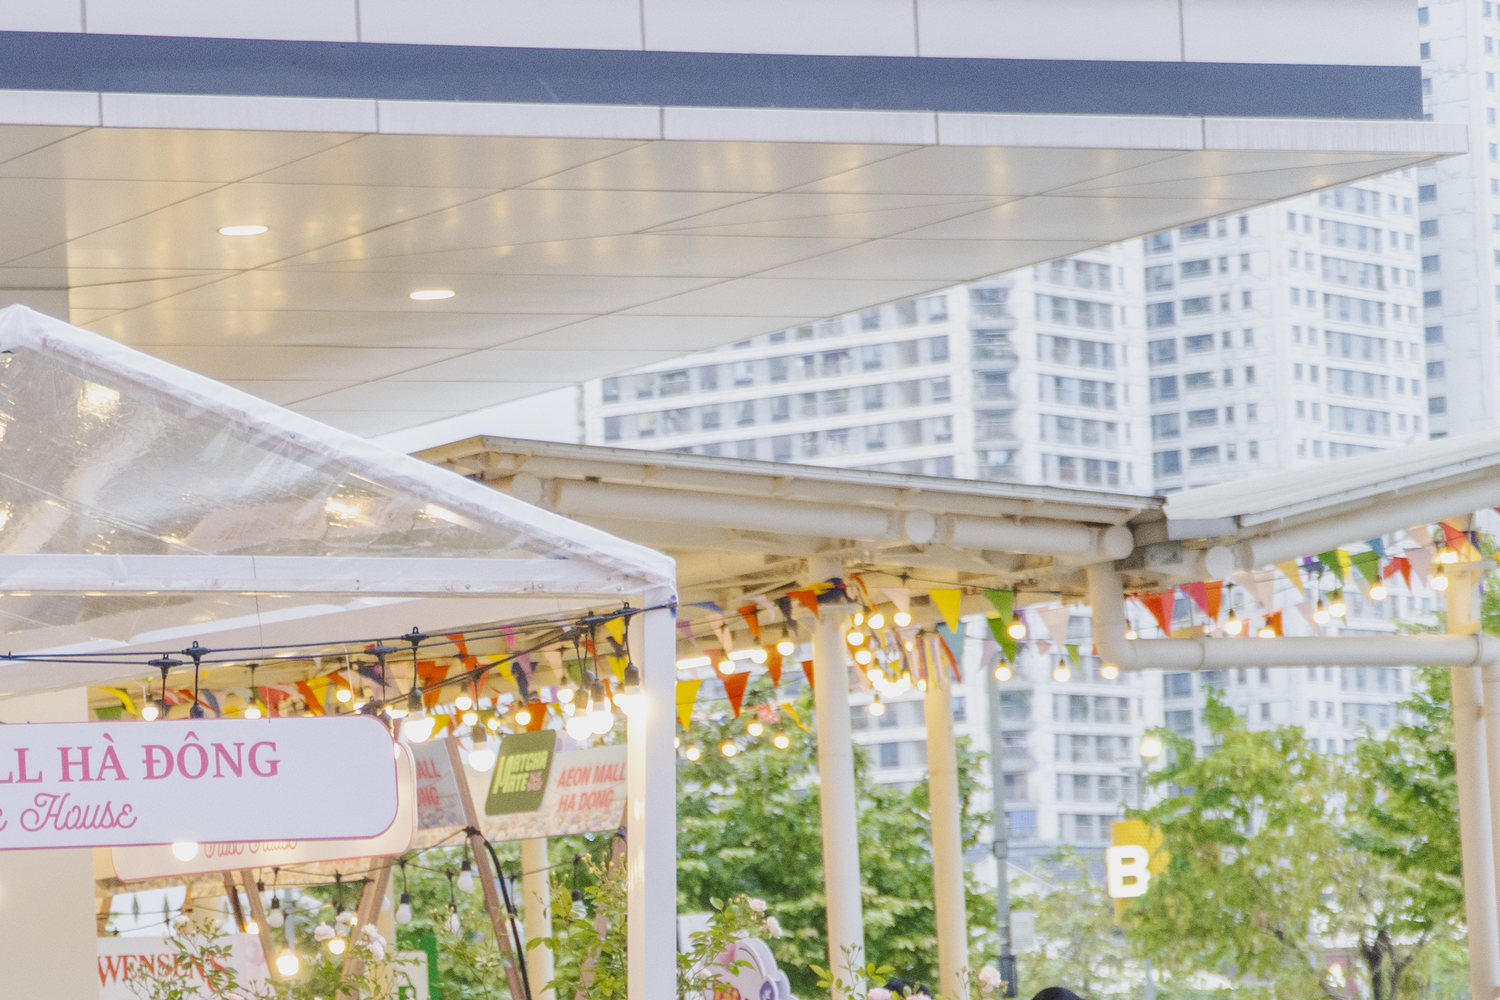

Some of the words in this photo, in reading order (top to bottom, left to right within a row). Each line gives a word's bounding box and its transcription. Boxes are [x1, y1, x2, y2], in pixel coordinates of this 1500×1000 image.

[57, 732, 129, 783] HÀ
[141, 730, 281, 780] ĐÔNG
[557, 766, 592, 788] AEON
[593, 761, 626, 784] MALL
[20, 792, 137, 832] House
[557, 793, 576, 813] HA
[578, 788, 615, 811] DONG
[1107, 845, 1150, 898] B
